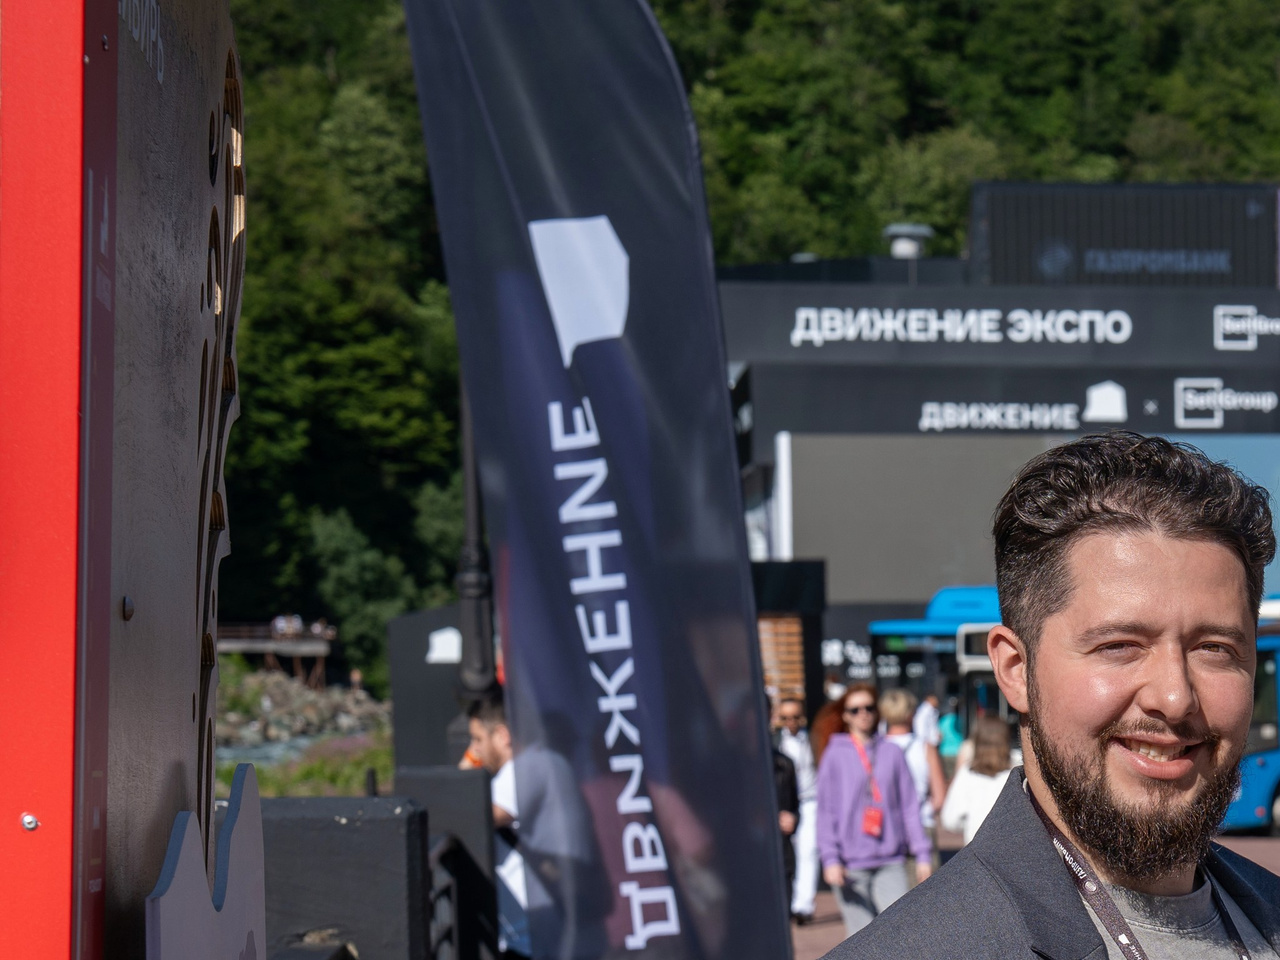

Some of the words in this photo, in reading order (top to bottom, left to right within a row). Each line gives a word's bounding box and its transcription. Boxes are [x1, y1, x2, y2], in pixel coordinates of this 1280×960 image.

[790, 307, 1004, 347] ДВИЖЕНИЕ
[1006, 309, 1133, 344] ЭКСПО
[918, 401, 1080, 431] ДВИЖЕНИЕ
